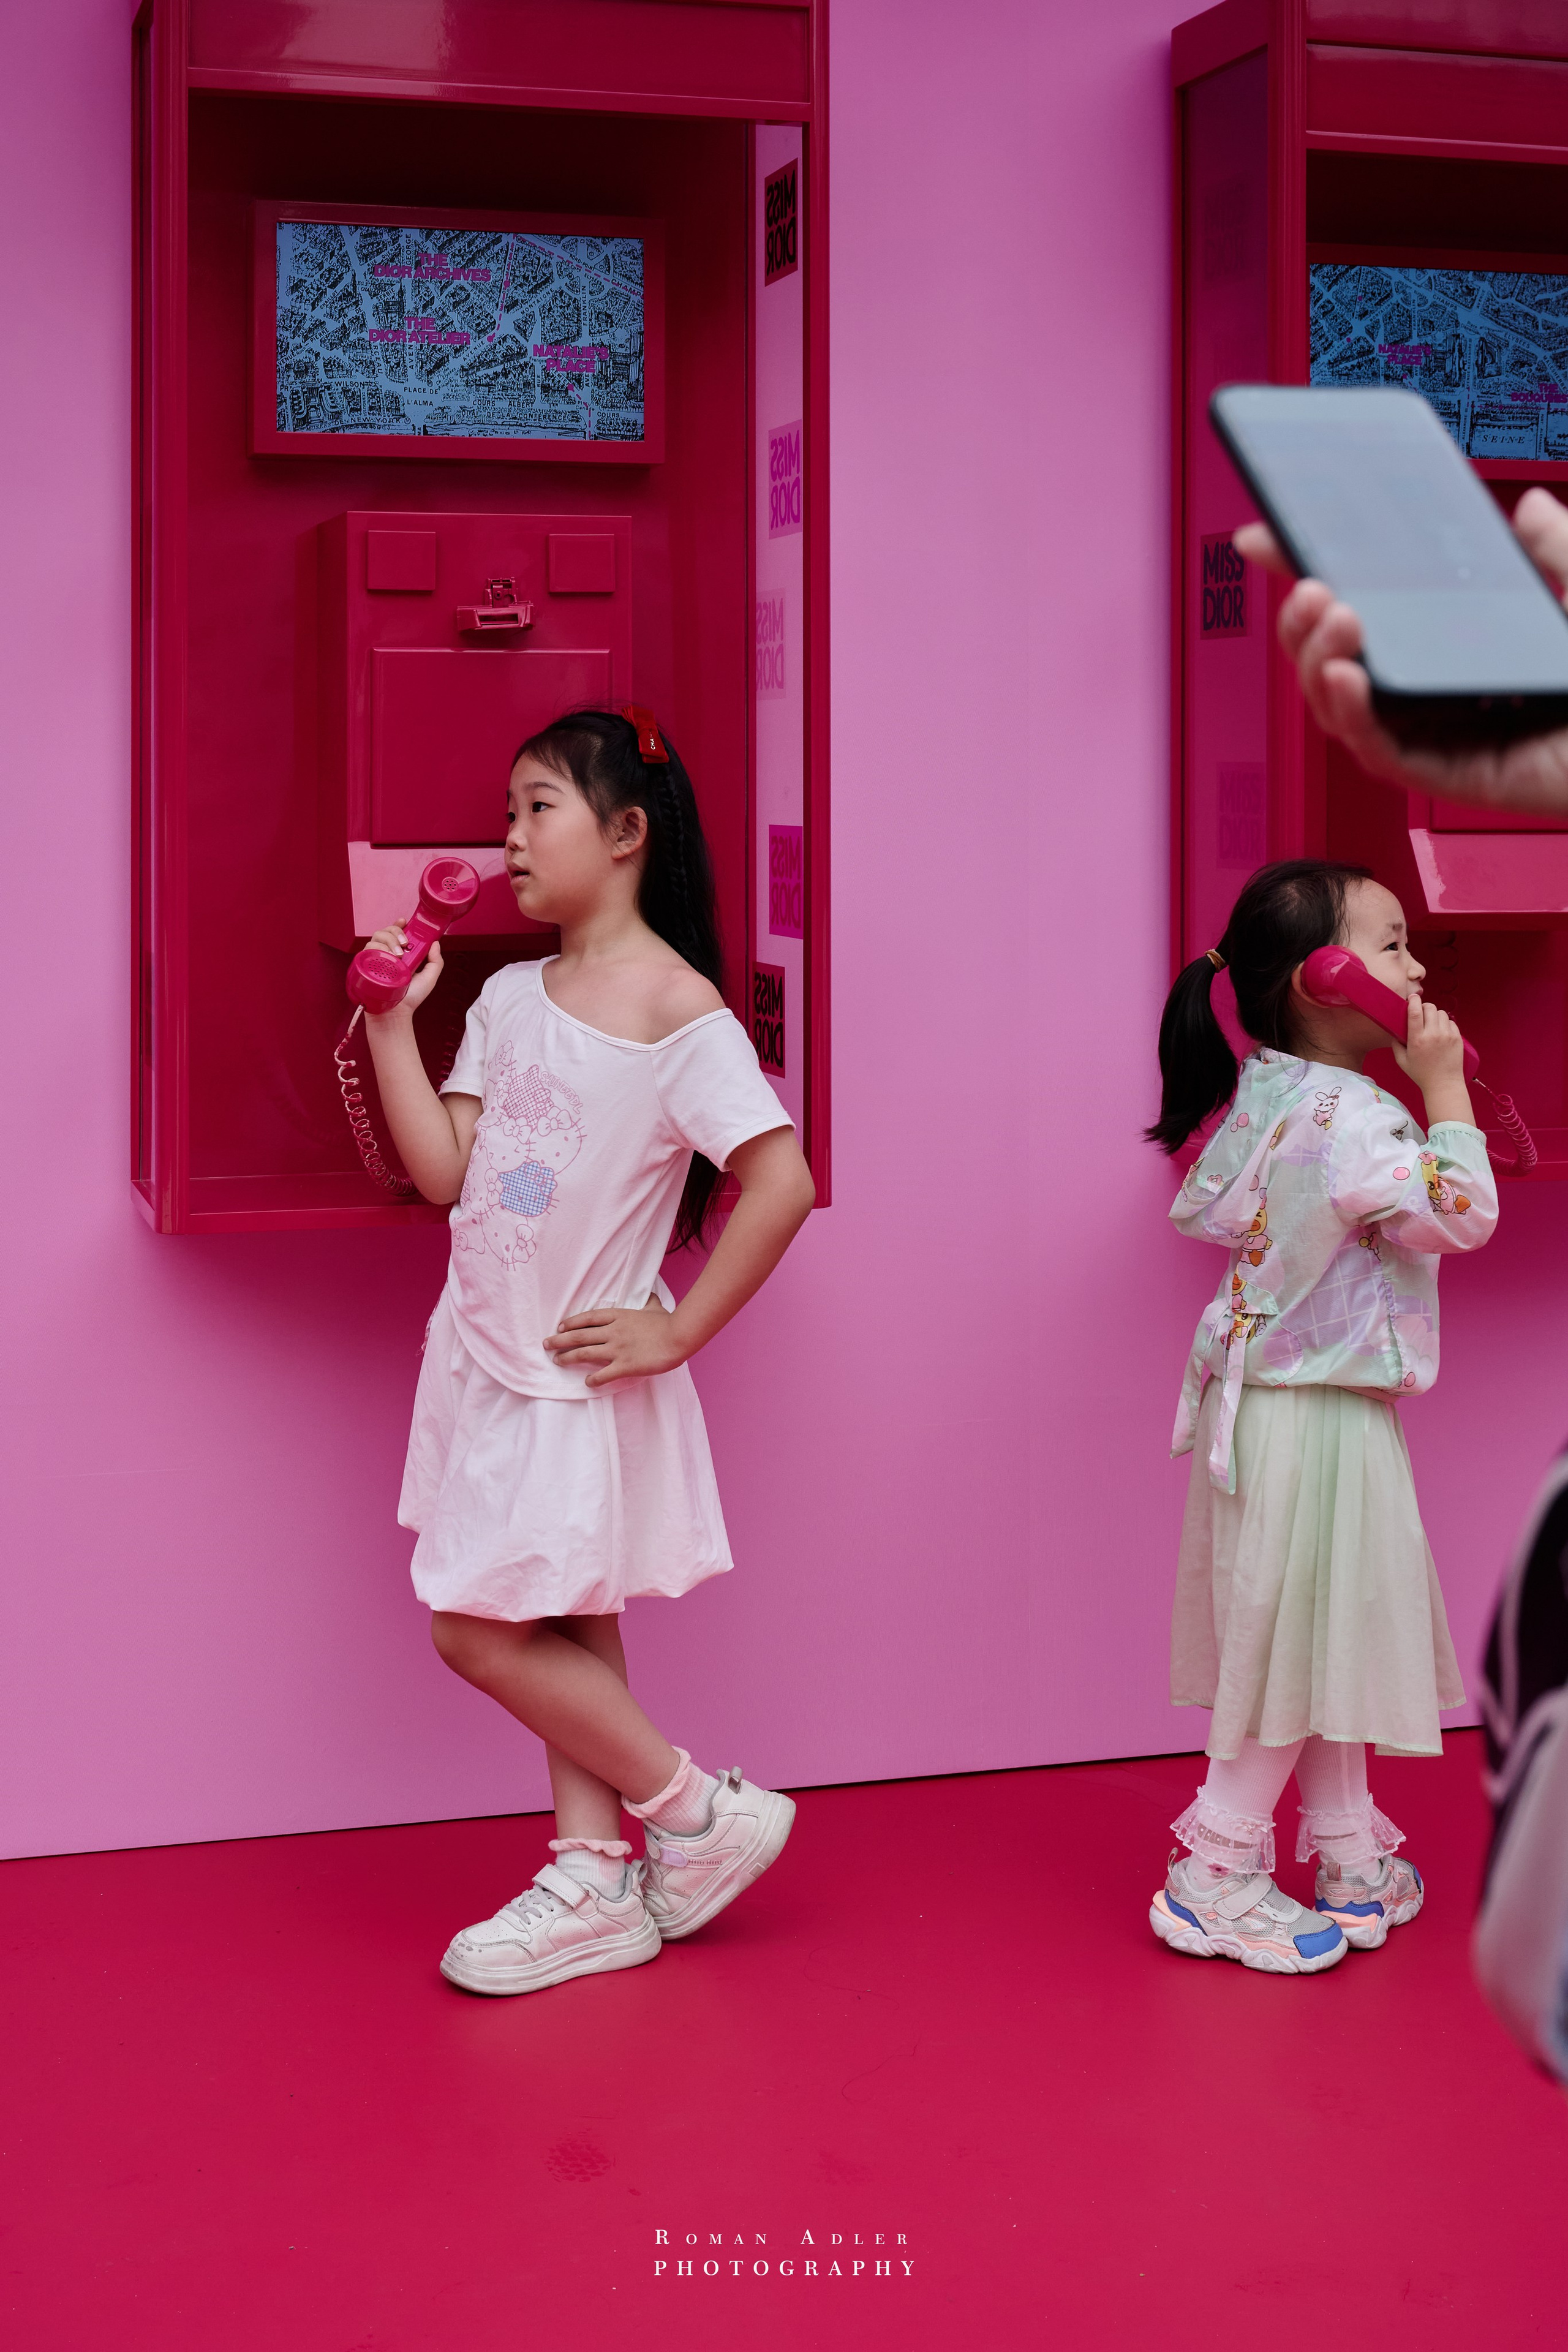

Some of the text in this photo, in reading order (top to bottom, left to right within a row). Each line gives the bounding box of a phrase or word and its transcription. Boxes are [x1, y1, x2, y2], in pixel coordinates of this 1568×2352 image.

[418, 252, 448, 266] THE
[374, 265, 491, 282] DIOR ARCHIVES
[611, 279, 643, 299] CHAMP
[320, 290, 338, 309] CHAILLOT
[521, 287, 554, 315] MONTAIGNE
[1432, 294, 1458, 311] CHAMPS
[309, 328, 330, 343] PIERRE
[376, 287, 396, 302] SERBIE
[404, 317, 435, 330] THE
[369, 328, 407, 343] DIOR
[409, 331, 470, 345] ATELIER
[462, 341, 485, 361] AVENUE
[533, 344, 609, 360] NATALIE'S
[1378, 344, 1431, 356] NATALIE'S
[277, 353, 296, 366] VENUE
[546, 358, 595, 373] PLACE
[1387, 354, 1422, 366] PLACE
[1538, 383, 1559, 393] THE
[1204, 541, 1245, 586] MISS
[1204, 586, 1244, 631] DIOR
